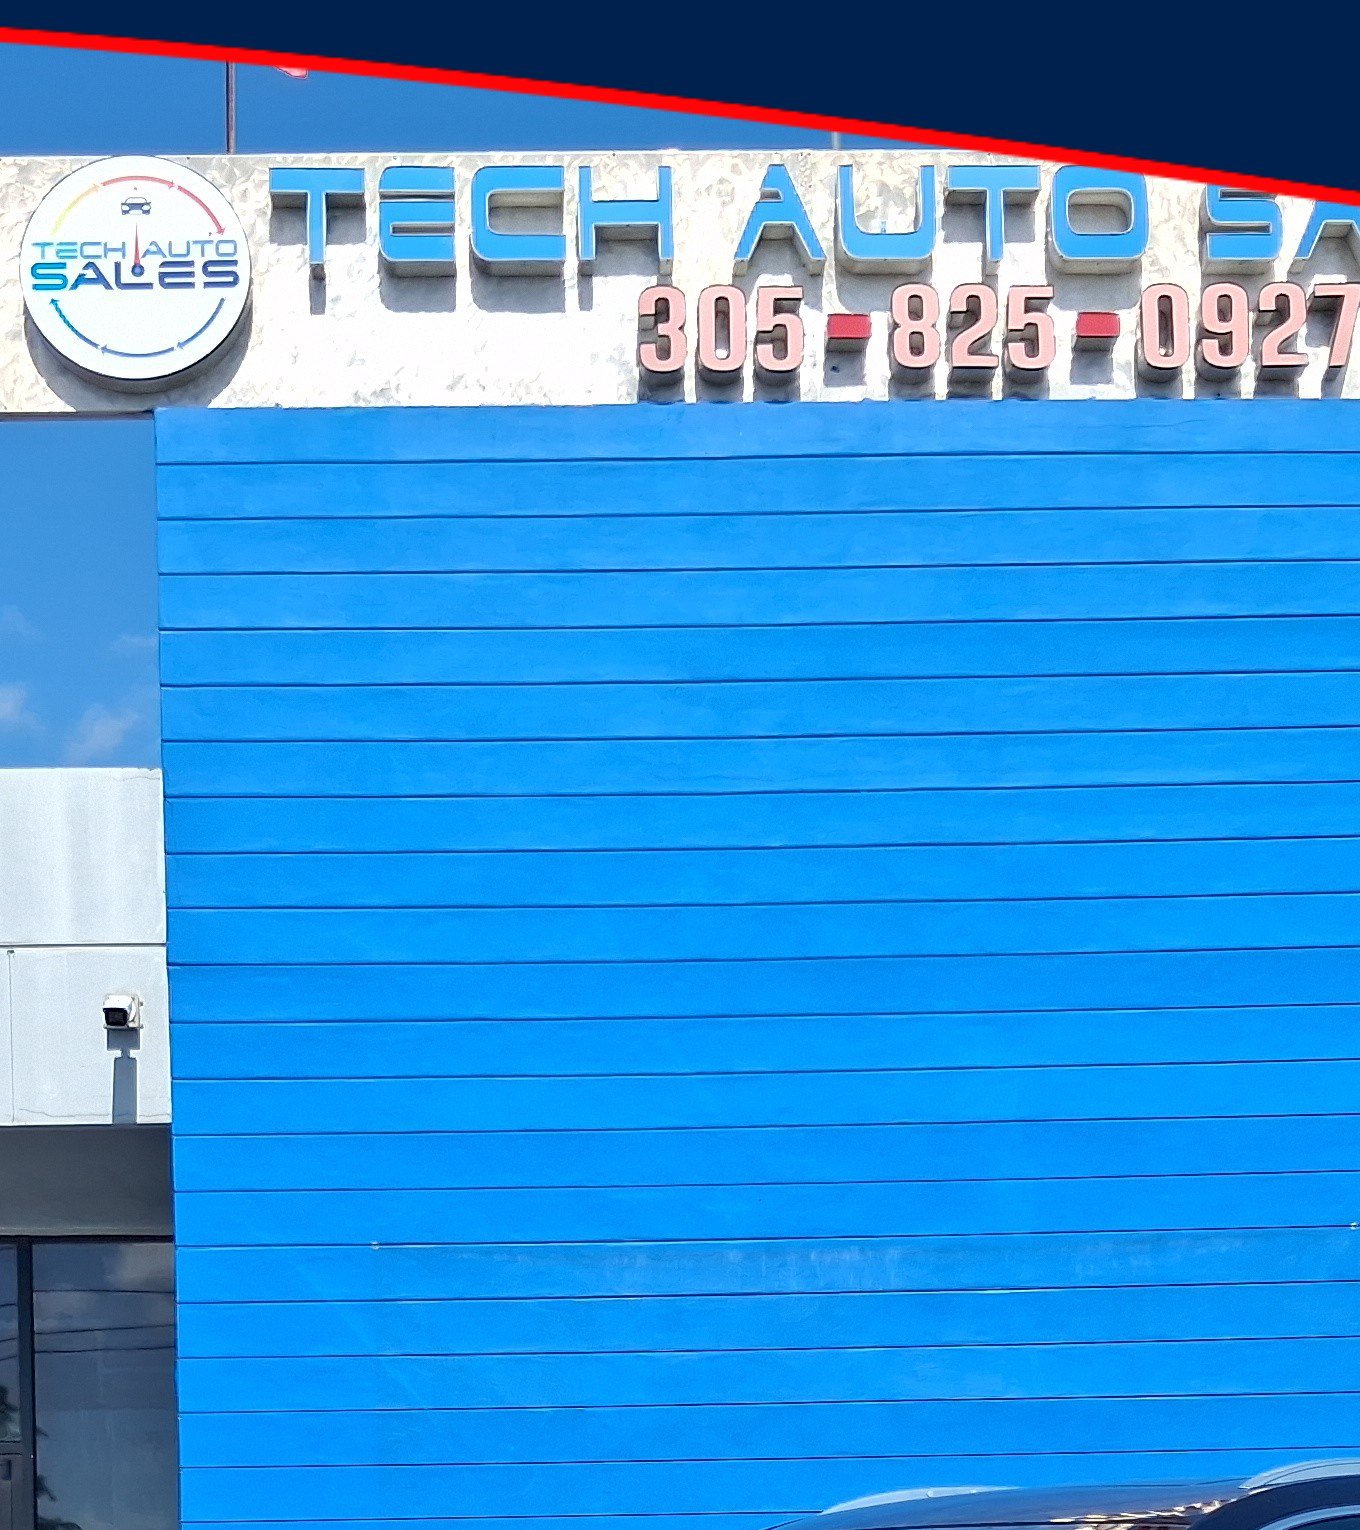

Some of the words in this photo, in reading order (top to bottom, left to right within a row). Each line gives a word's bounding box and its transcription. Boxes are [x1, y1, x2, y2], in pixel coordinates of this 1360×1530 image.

[269, 164, 674, 268] TECH
[733, 163, 1148, 268] AUTO
[31, 241, 127, 260] TECH
[140, 239, 239, 259] AUTO
[30, 259, 240, 291] SALES
